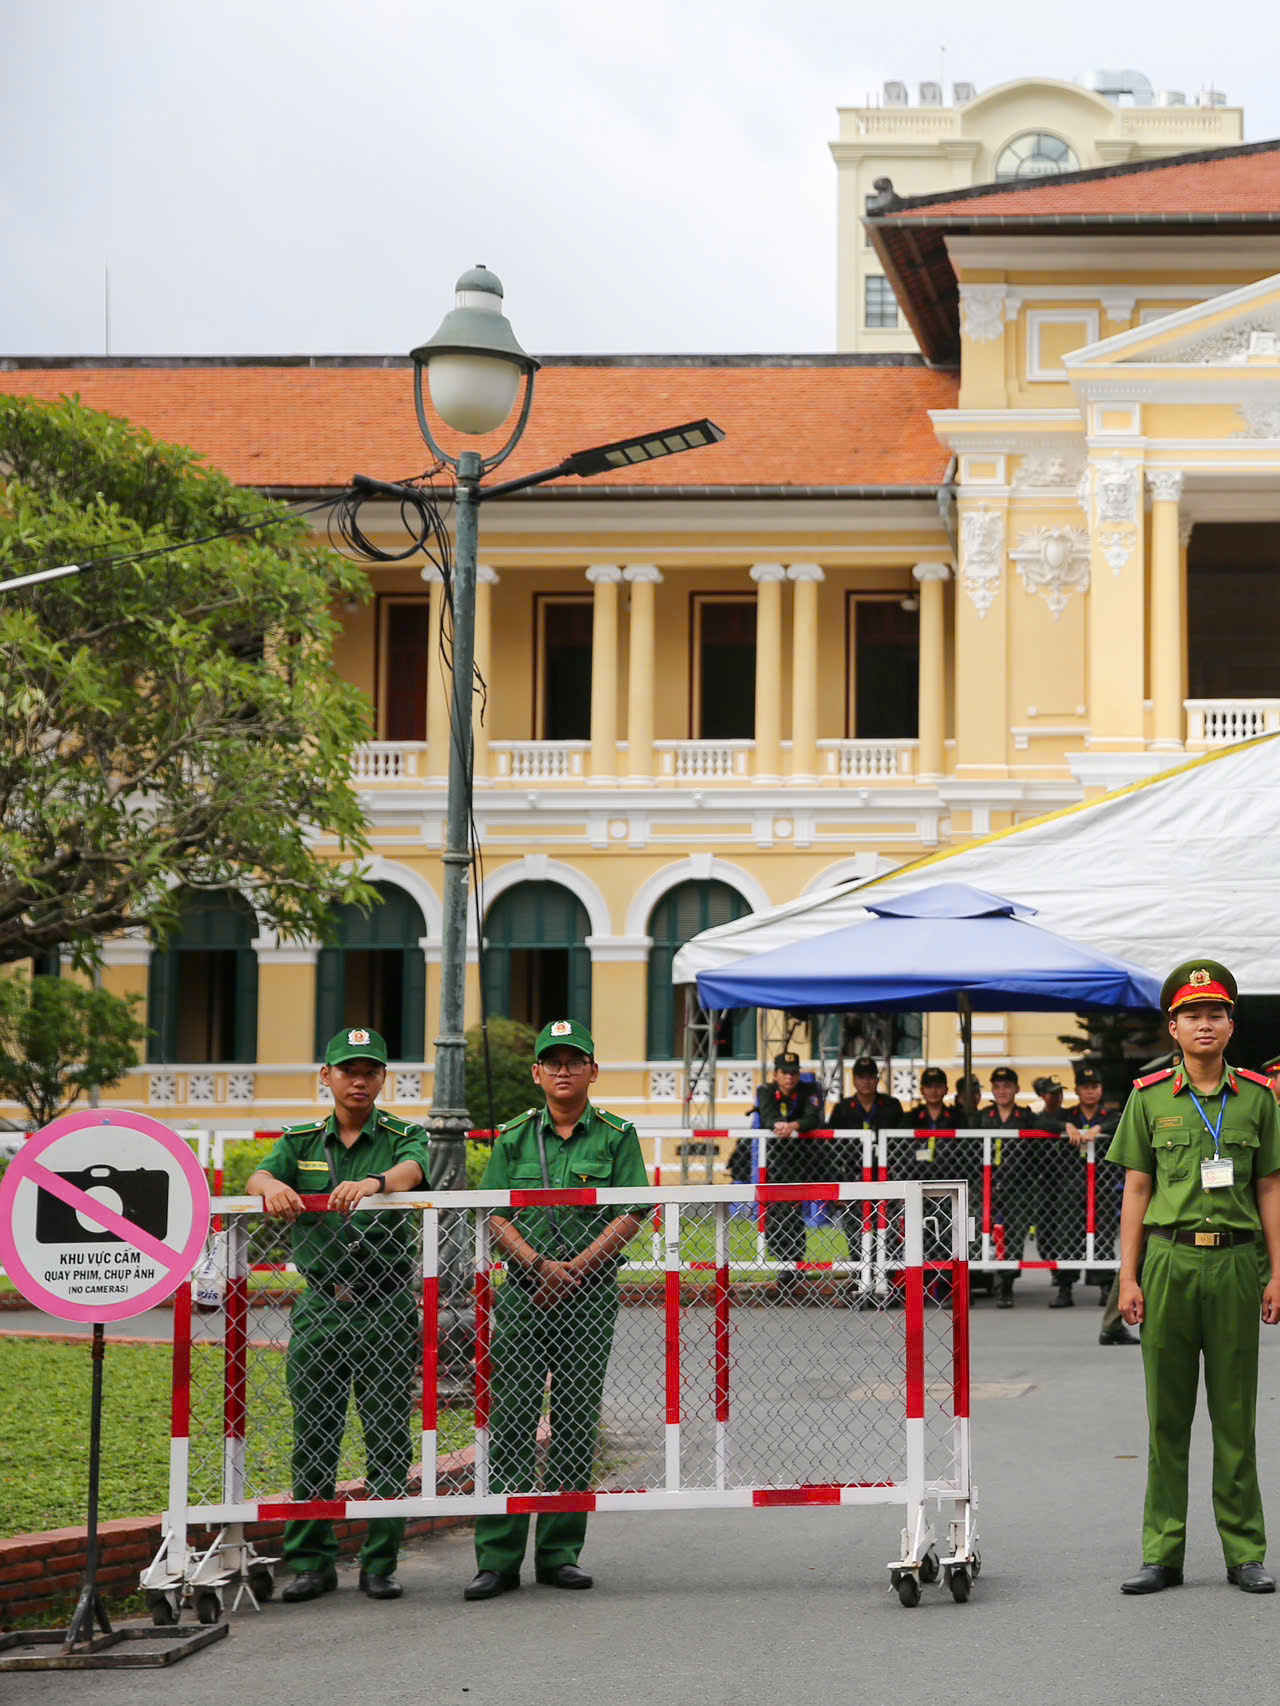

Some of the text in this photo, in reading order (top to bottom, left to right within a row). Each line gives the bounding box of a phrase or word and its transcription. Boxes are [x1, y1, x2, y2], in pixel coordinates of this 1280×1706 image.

[60, 1248, 140, 1266] KHU VỰC CẤM
[44, 1266, 154, 1282] QUAY PHIM, CHỤP ẢNH
[69, 1285, 128, 1294] (NO CAMERAS)
